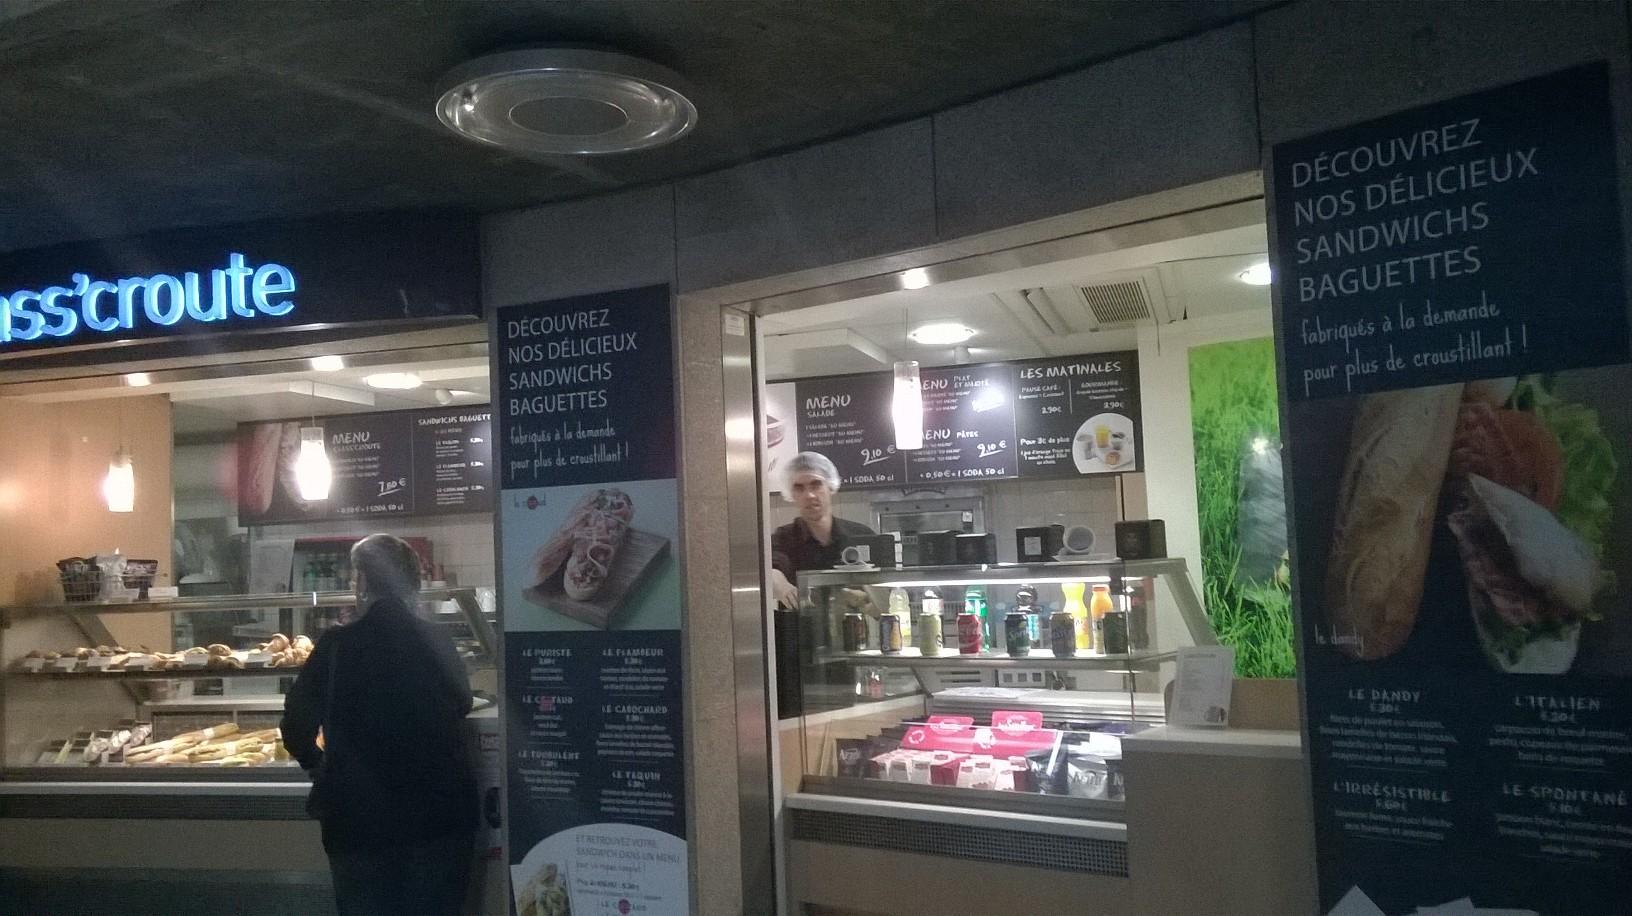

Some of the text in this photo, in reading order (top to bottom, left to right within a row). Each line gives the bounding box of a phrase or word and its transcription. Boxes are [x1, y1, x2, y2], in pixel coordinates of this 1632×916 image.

[1292, 118, 1483, 188] DÉCOUVREZ
[1294, 148, 1538, 227] NOS DÉLICIEUX
[1297, 202, 1489, 265] SANDWICHS
[1300, 245, 1482, 302] BAGUETTES
[508, 308, 610, 338] DÉCOUVREZ
[1302, 290, 1500, 353] fabriqués à la demande
[508, 332, 637, 365] NOS DÉLICIEUX
[1020, 361, 1121, 379] LES MATINALES
[1303, 364, 1336, 398] pour
[1346, 348, 1378, 393] plus
[1386, 343, 1406, 371] de
[1413, 327, 1512, 368] croustillant
[509, 362, 613, 390] SANDWICHS
[921, 378, 948, 391] ENU
[510, 389, 608, 416] BAGUETTES
[805, 394, 851, 410] MENU
[807, 410, 835, 418] SALADE
[332, 431, 370, 445] MENU
[510, 417, 616, 453] fabriqués à la demande
[923, 428, 950, 441] ENU
[510, 459, 529, 480] pour
[534, 448, 552, 479] plus
[556, 448, 567, 467] de
[570, 442, 621, 464] croustillant
[962, 469, 984, 477] SODA
[985, 467, 996, 476] 50
[997, 467, 1005, 475] cl
[854, 474, 874, 483] SODA
[1314, 623, 1327, 645] le
[1348, 688, 1421, 703] LE DANDY
[1514, 695, 1601, 711] L'ITALIEN
[1333, 780, 1452, 803] L'IRRÉSISTIBLE
[1503, 782, 1627, 806] LE SPONTANÉ
